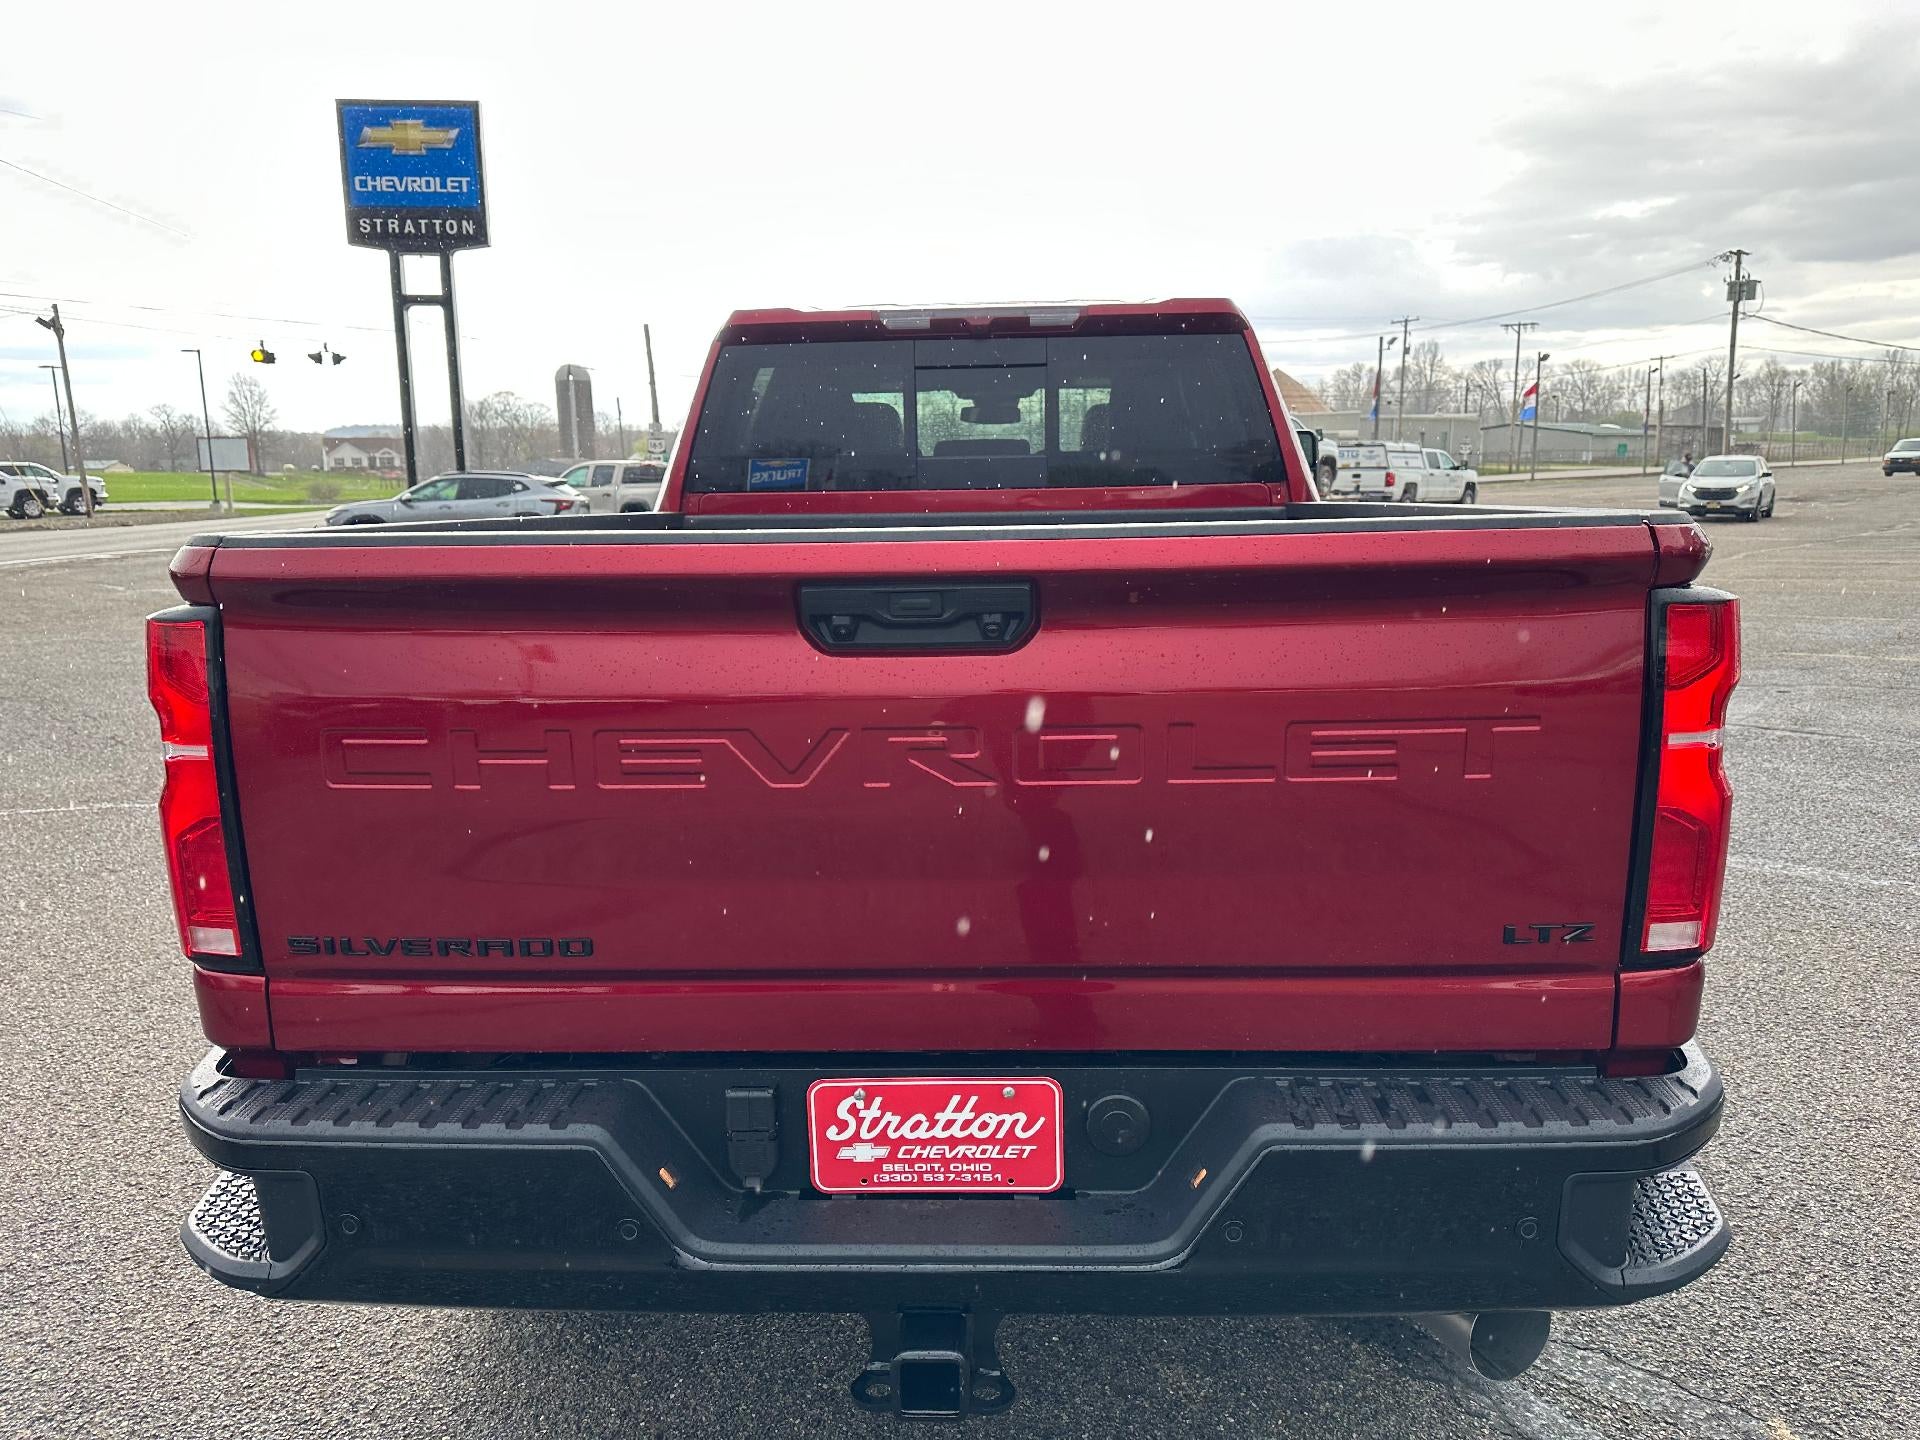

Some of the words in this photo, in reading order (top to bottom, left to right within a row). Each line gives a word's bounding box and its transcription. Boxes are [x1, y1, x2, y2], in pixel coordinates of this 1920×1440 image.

[354, 175, 471, 193] CHEVROLET
[359, 218, 474, 235] STRATTON
[320, 716, 1541, 789] CHEVROLET
[1503, 922, 1596, 944] LTZ
[287, 935, 594, 958] SILVERADO
[826, 1094, 1046, 1141] Stratton
[897, 1145, 1038, 1159] CHEVROLET
[882, 1163, 945, 1172] BELOIT,
[950, 1163, 992, 1172] OHIO
[873, 1173, 918, 1183] (330)
[923, 1173, 1002, 1183] 537-3151
